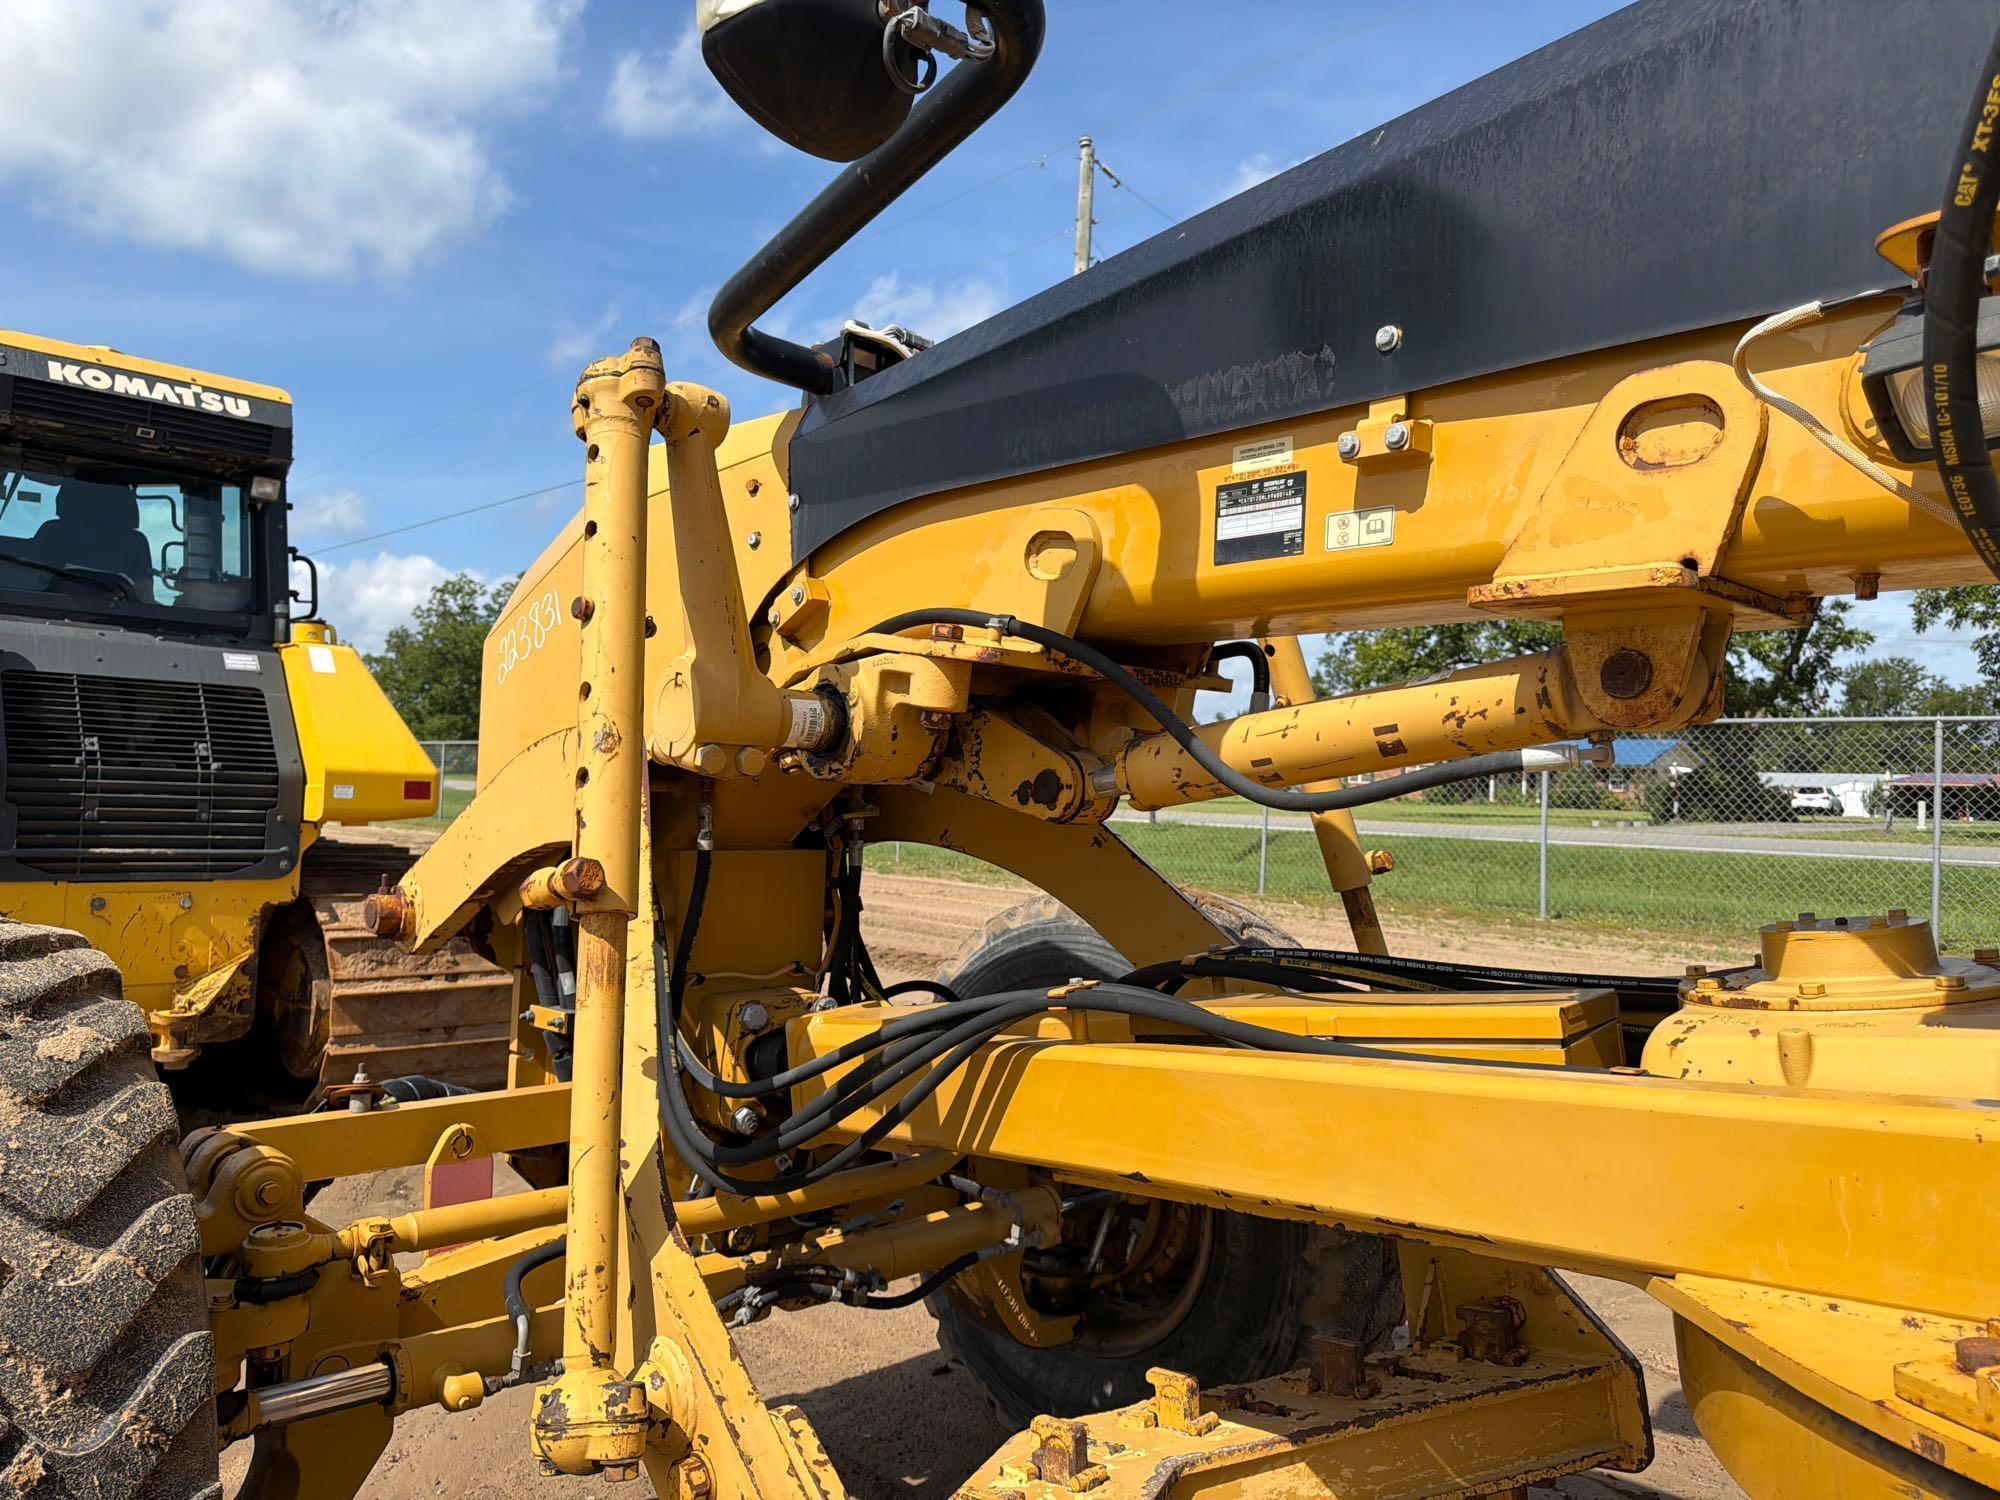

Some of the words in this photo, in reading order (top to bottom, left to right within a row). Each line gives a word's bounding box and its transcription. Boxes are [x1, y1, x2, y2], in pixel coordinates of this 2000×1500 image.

[47, 360, 251, 418] KOMATSU
[1933, 363, 1952, 427] IC-101/10
[1940, 429, 1960, 466] MSHA
[1950, 475, 1976, 518] 1E0736
[497, 587, 562, 685] 223831
[1360, 955, 1373, 963] MPa
[1406, 961, 1426, 969] MSHA
[1582, 978, 1638, 987] www.parker.com
